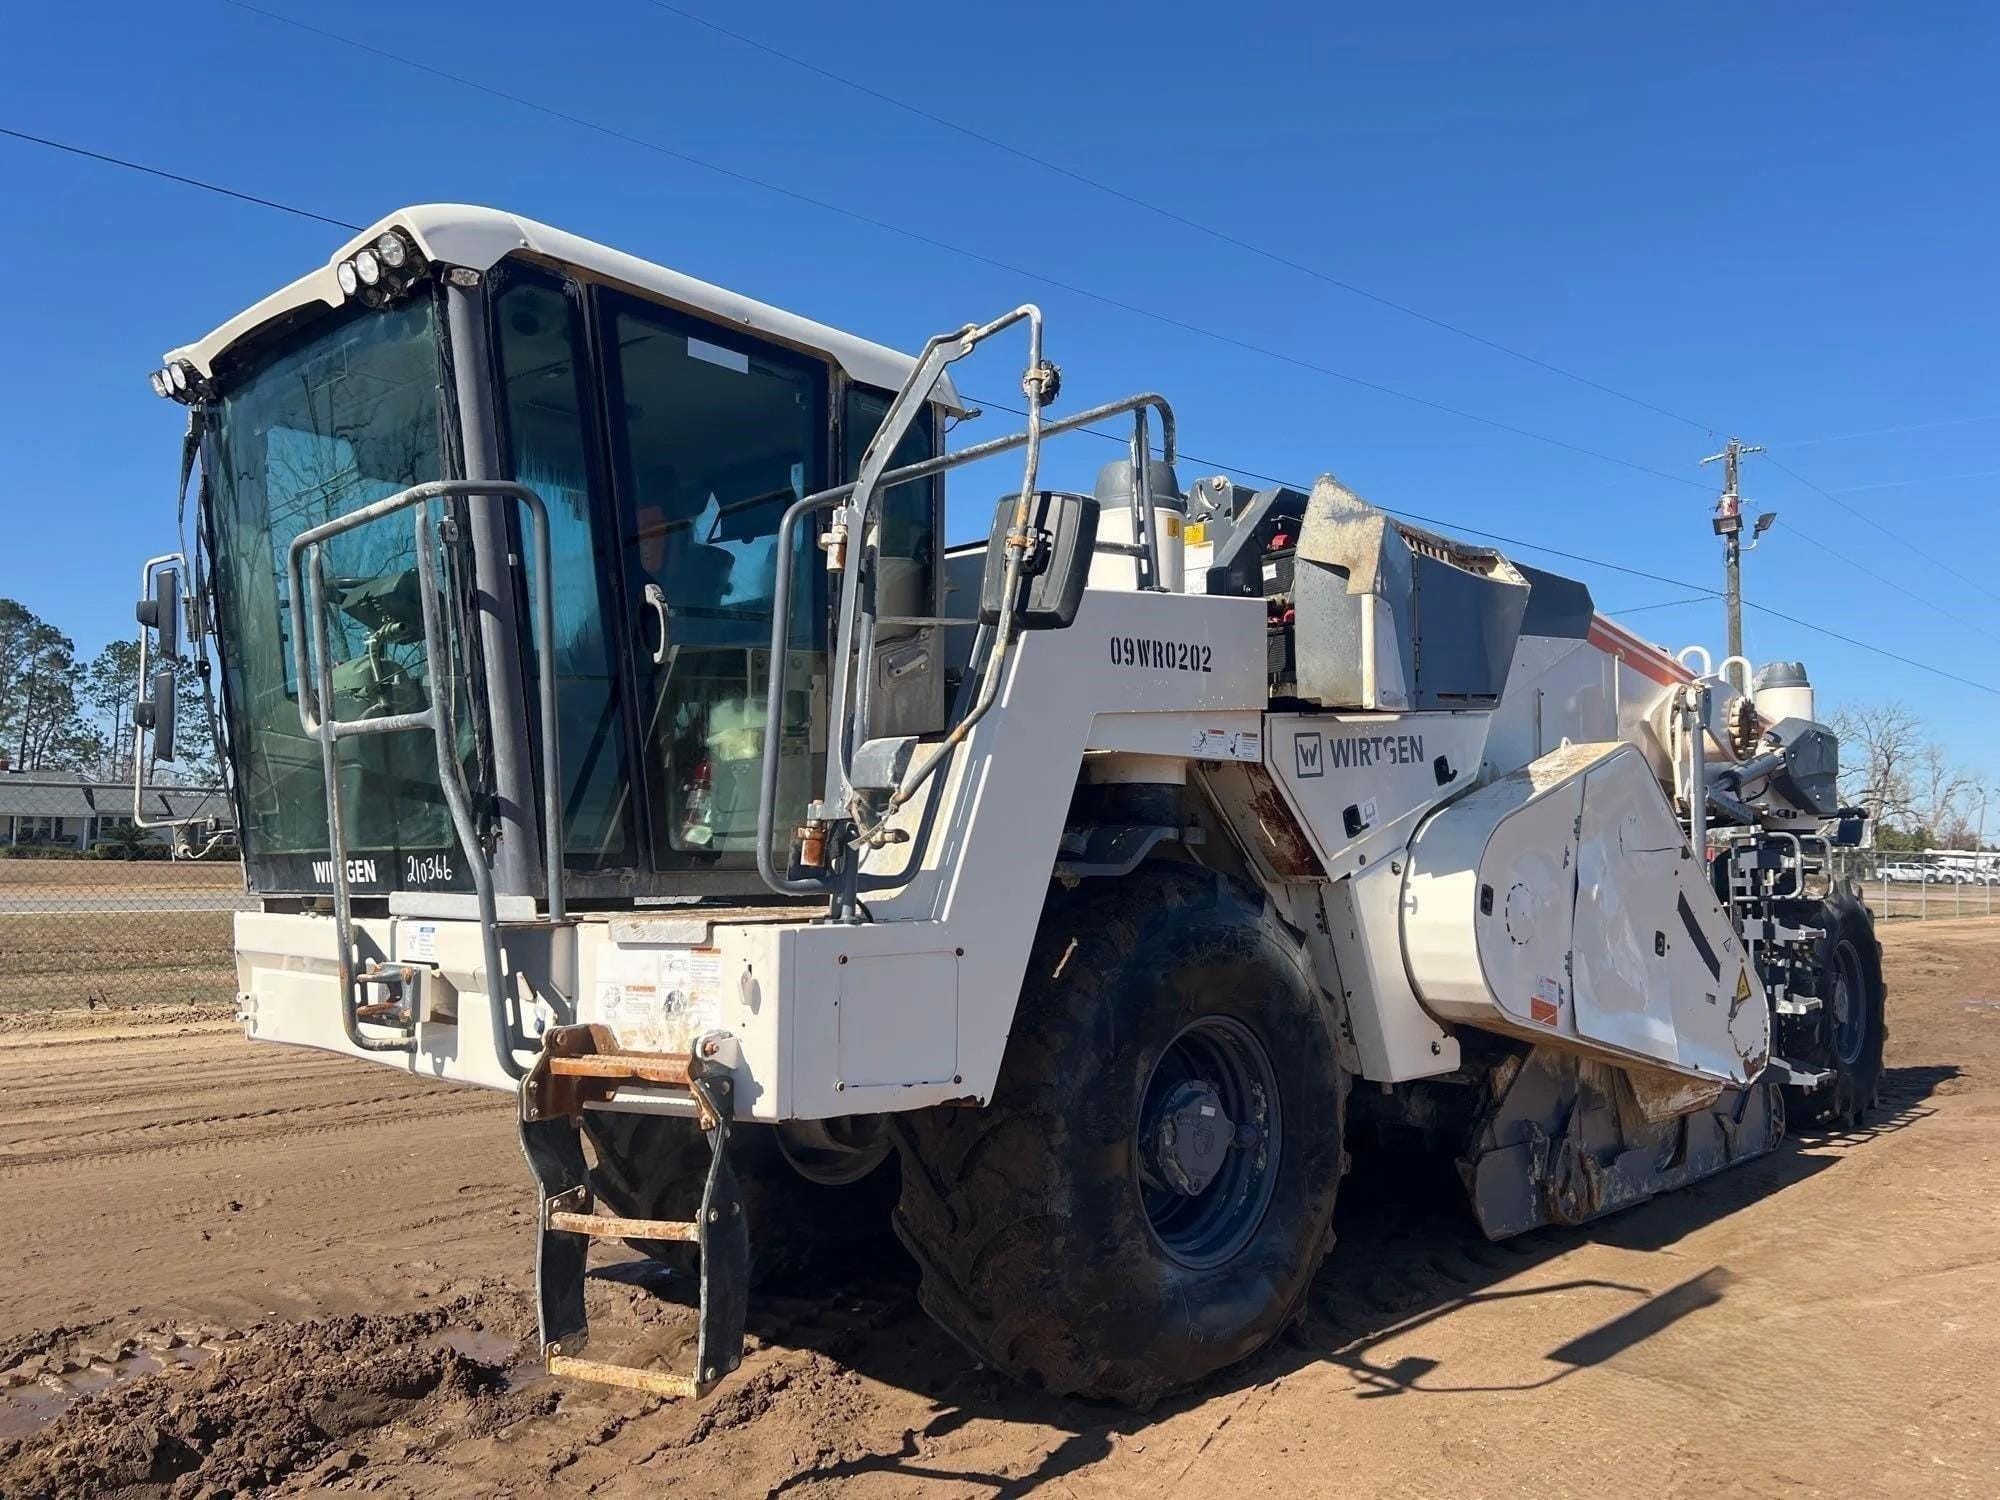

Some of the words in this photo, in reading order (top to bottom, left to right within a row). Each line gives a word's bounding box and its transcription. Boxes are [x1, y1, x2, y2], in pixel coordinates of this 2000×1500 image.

[1110, 636, 1212, 673] 09WR0202
[1329, 735, 1425, 769] WIRTGEN
[312, 859, 378, 884] WIGEN
[407, 854, 453, 884] 210366
